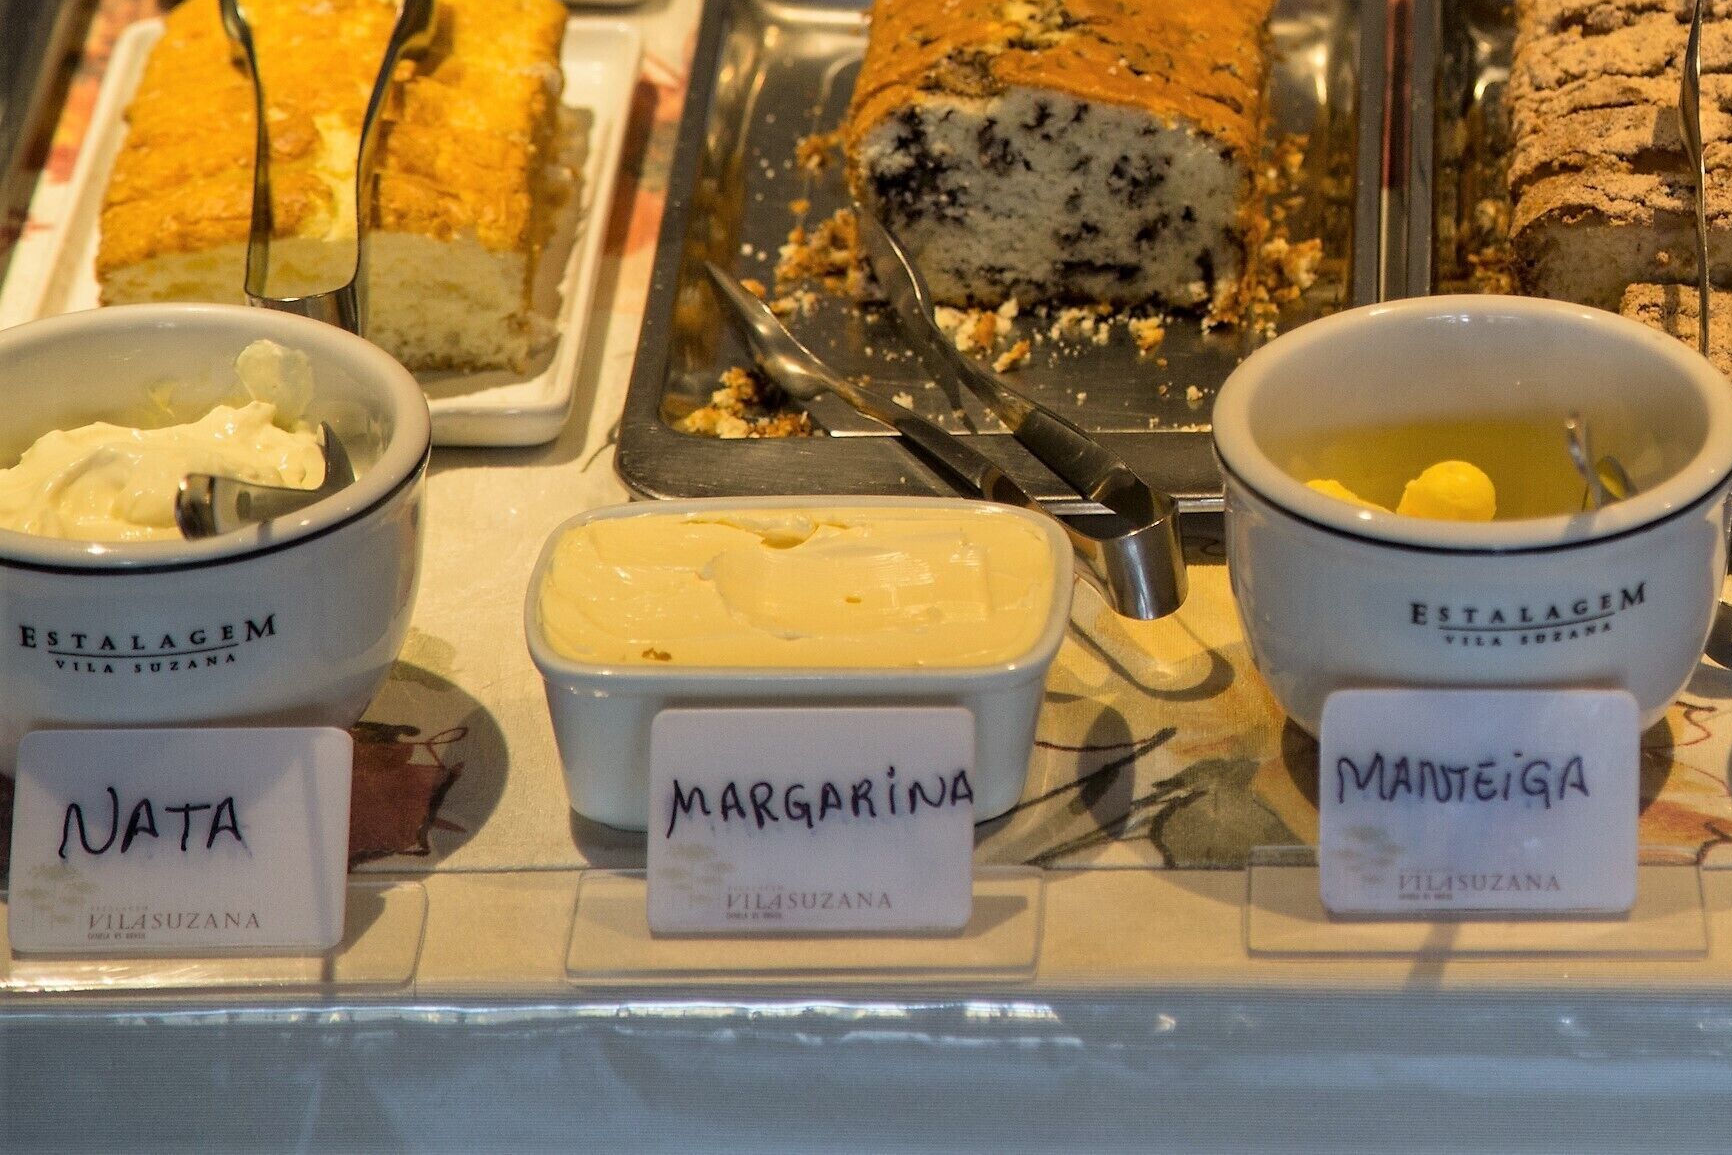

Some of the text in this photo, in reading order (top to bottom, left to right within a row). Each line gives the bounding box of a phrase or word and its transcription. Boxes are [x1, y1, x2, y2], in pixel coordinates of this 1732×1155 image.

[1410, 581, 1646, 626] ESTALAGEM
[18, 613, 276, 650] ESTALAGEM
[1445, 622, 1612, 647] VILA SUZANA
[55, 653, 235, 674] VILA SUZANA
[58, 786, 244, 860] NATA
